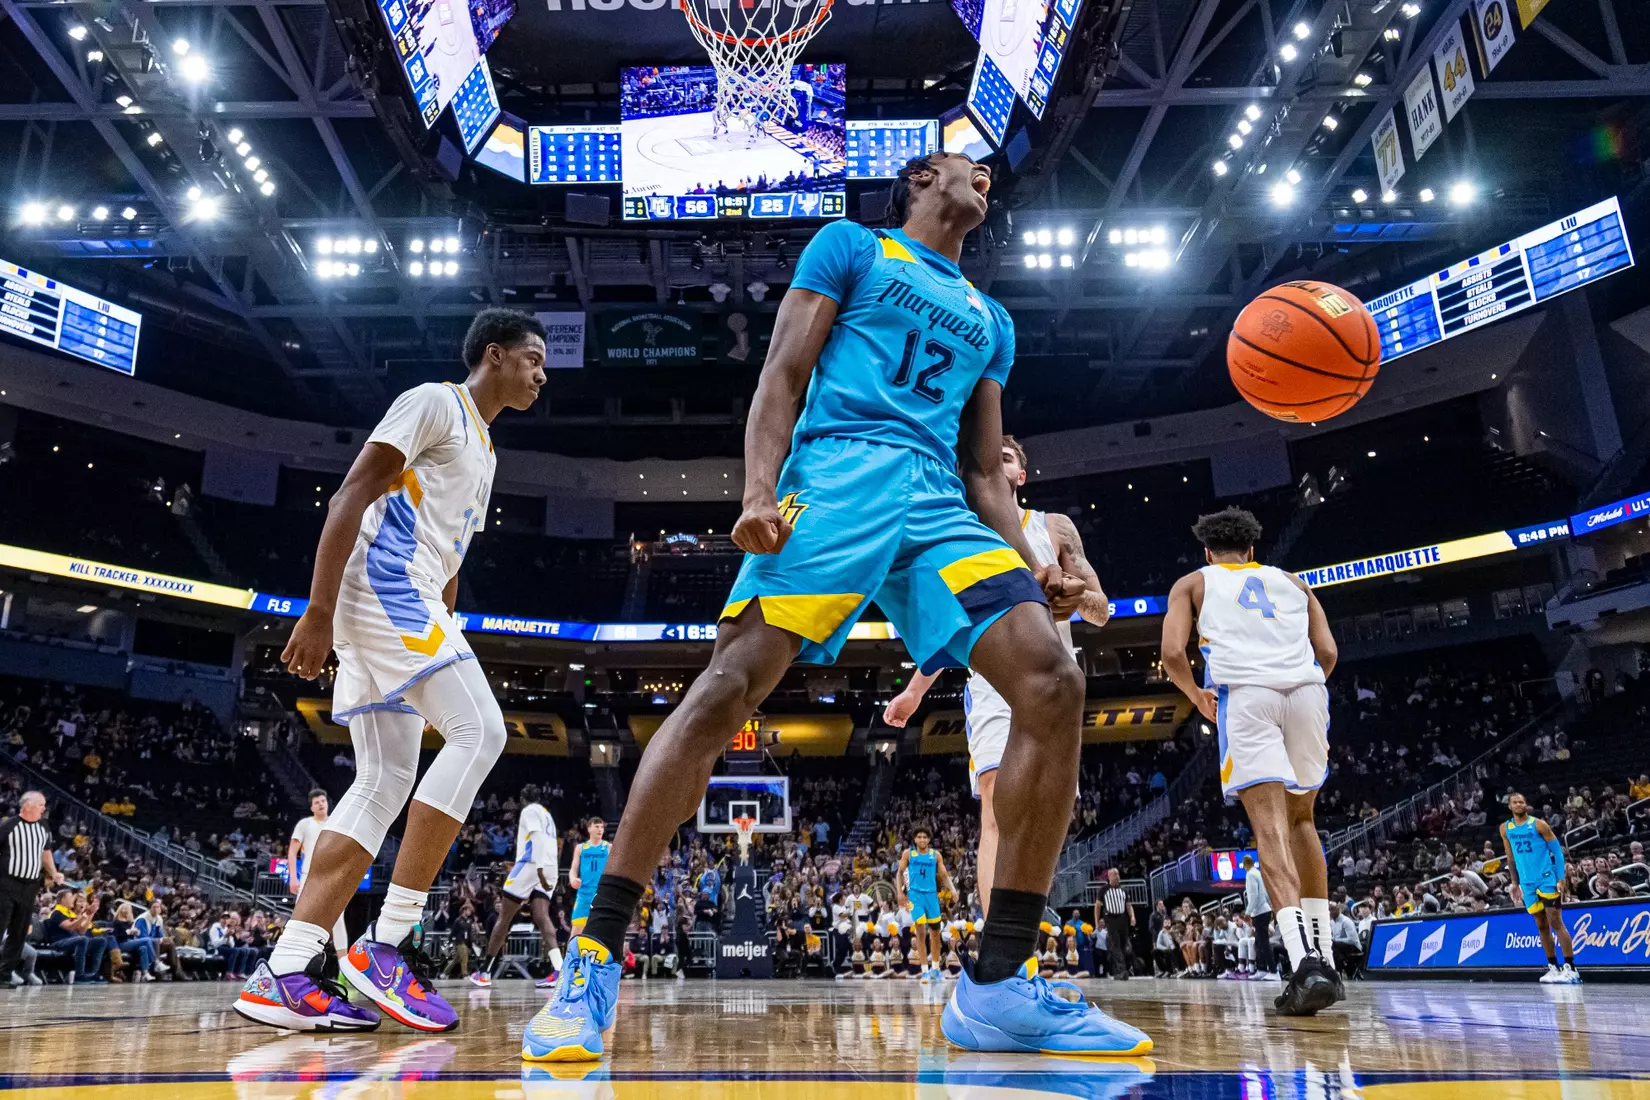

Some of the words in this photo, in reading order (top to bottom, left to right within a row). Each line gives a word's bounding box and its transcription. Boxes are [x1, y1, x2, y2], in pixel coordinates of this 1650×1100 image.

[1485, 3, 1503, 39] 24
[1444, 46, 1467, 92] 44
[1411, 89, 1435, 131] HANK
[1377, 129, 1397, 177] 77
[685, 200, 708, 214] 56
[717, 197, 748, 207] 16:51
[760, 199, 784, 213] 25
[1560, 216, 1578, 232] LIU
[1461, 268, 1493, 288] ASSISTS
[1466, 281, 1493, 298] STEALS
[1366, 285, 1415, 313] MARQUETTE
[1468, 292, 1497, 311] BLOCKS
[877, 277, 991, 352] Marquette
[1463, 301, 1507, 326] TURNOVERS
[607, 348, 640, 359] WORLD
[642, 346, 697, 358] CHAMPIONS
[891, 328, 957, 404] 12
[1587, 507, 1624, 528] Michelob
[1548, 525, 1569, 538] PM
[69, 562, 90, 575] KILL
[93, 566, 140, 585] TRACKER:
[267, 599, 292, 613] FLS
[1133, 600, 1148, 614] 0
[1235, 575, 1278, 621] 4
[482, 617, 561, 635] MARQUETTE
[676, 624, 718, 640] 16:5
[1514, 840, 1533, 853] 23
[590, 860, 598, 872] 11
[919, 867, 927, 880] 4
[1505, 932, 1542, 949] Discove
[1572, 912, 1630, 956] Baird
[722, 940, 768, 961] meijer
[1462, 939, 1481, 950] BAIRD
